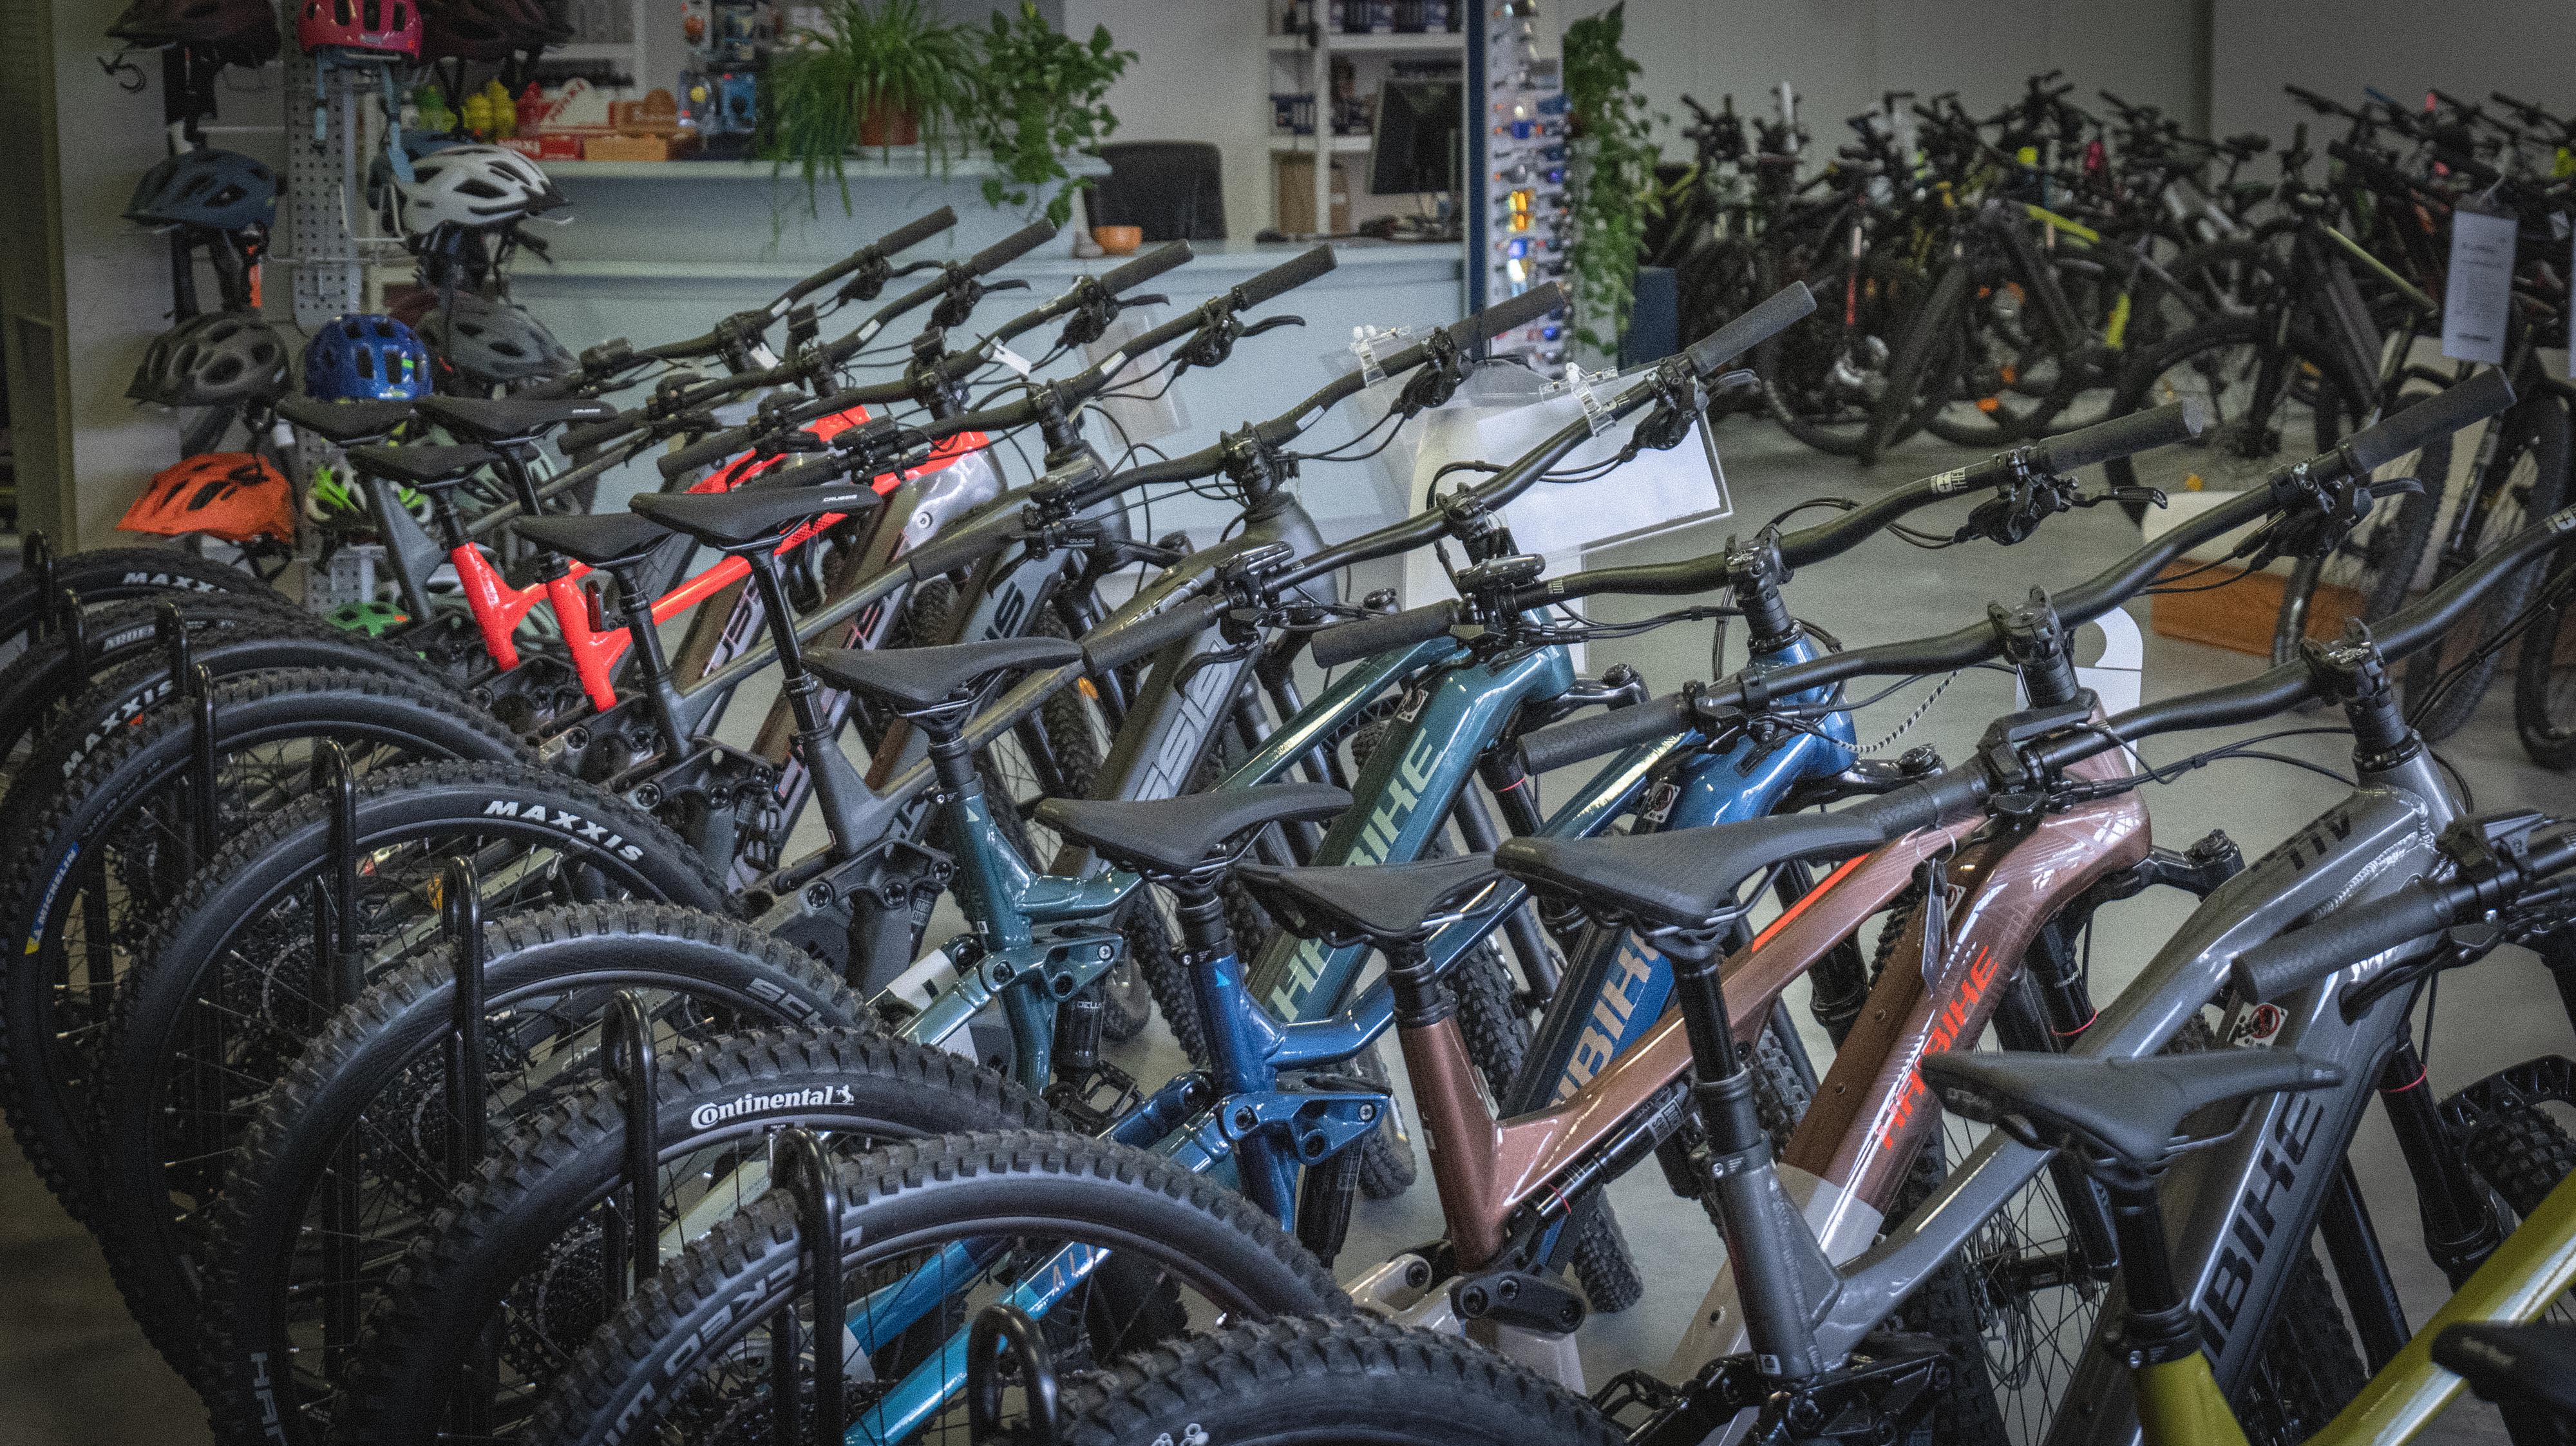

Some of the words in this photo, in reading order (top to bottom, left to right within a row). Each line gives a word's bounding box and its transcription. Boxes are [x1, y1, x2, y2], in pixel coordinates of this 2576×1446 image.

[122, 571, 228, 594] MAXX
[62, 680, 173, 778] MAXXIS
[484, 800, 643, 861] MAXXIS
[37, 848, 78, 926] MICHELIN
[690, 1085, 833, 1130] Continental
